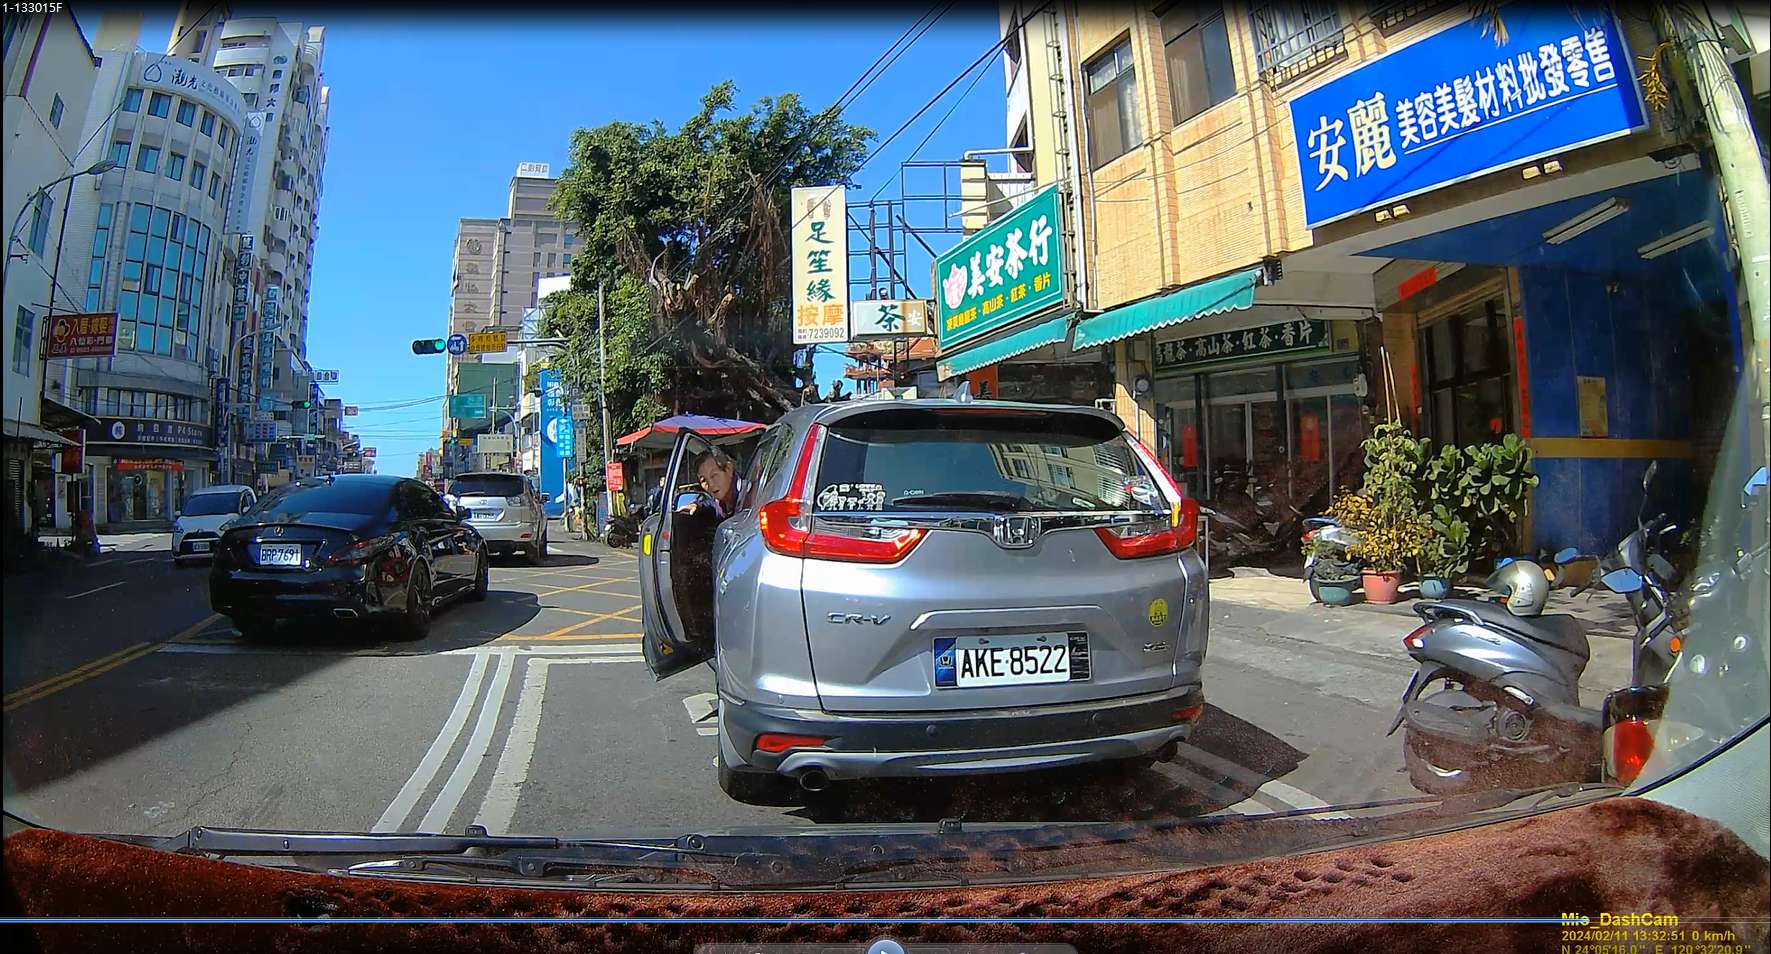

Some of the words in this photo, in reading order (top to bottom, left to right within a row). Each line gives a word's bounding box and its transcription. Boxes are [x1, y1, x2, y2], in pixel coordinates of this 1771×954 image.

[1307, 91, 1398, 192] 安麗
[1396, 27, 1616, 149] 美容美髮材料批發零售
[805, 220, 836, 303] 足笙緣
[968, 214, 1053, 298] 美安茶行
[797, 304, 844, 326] 按摩
[809, 327, 845, 340] 7239092
[828, 612, 891, 626] CR-V
